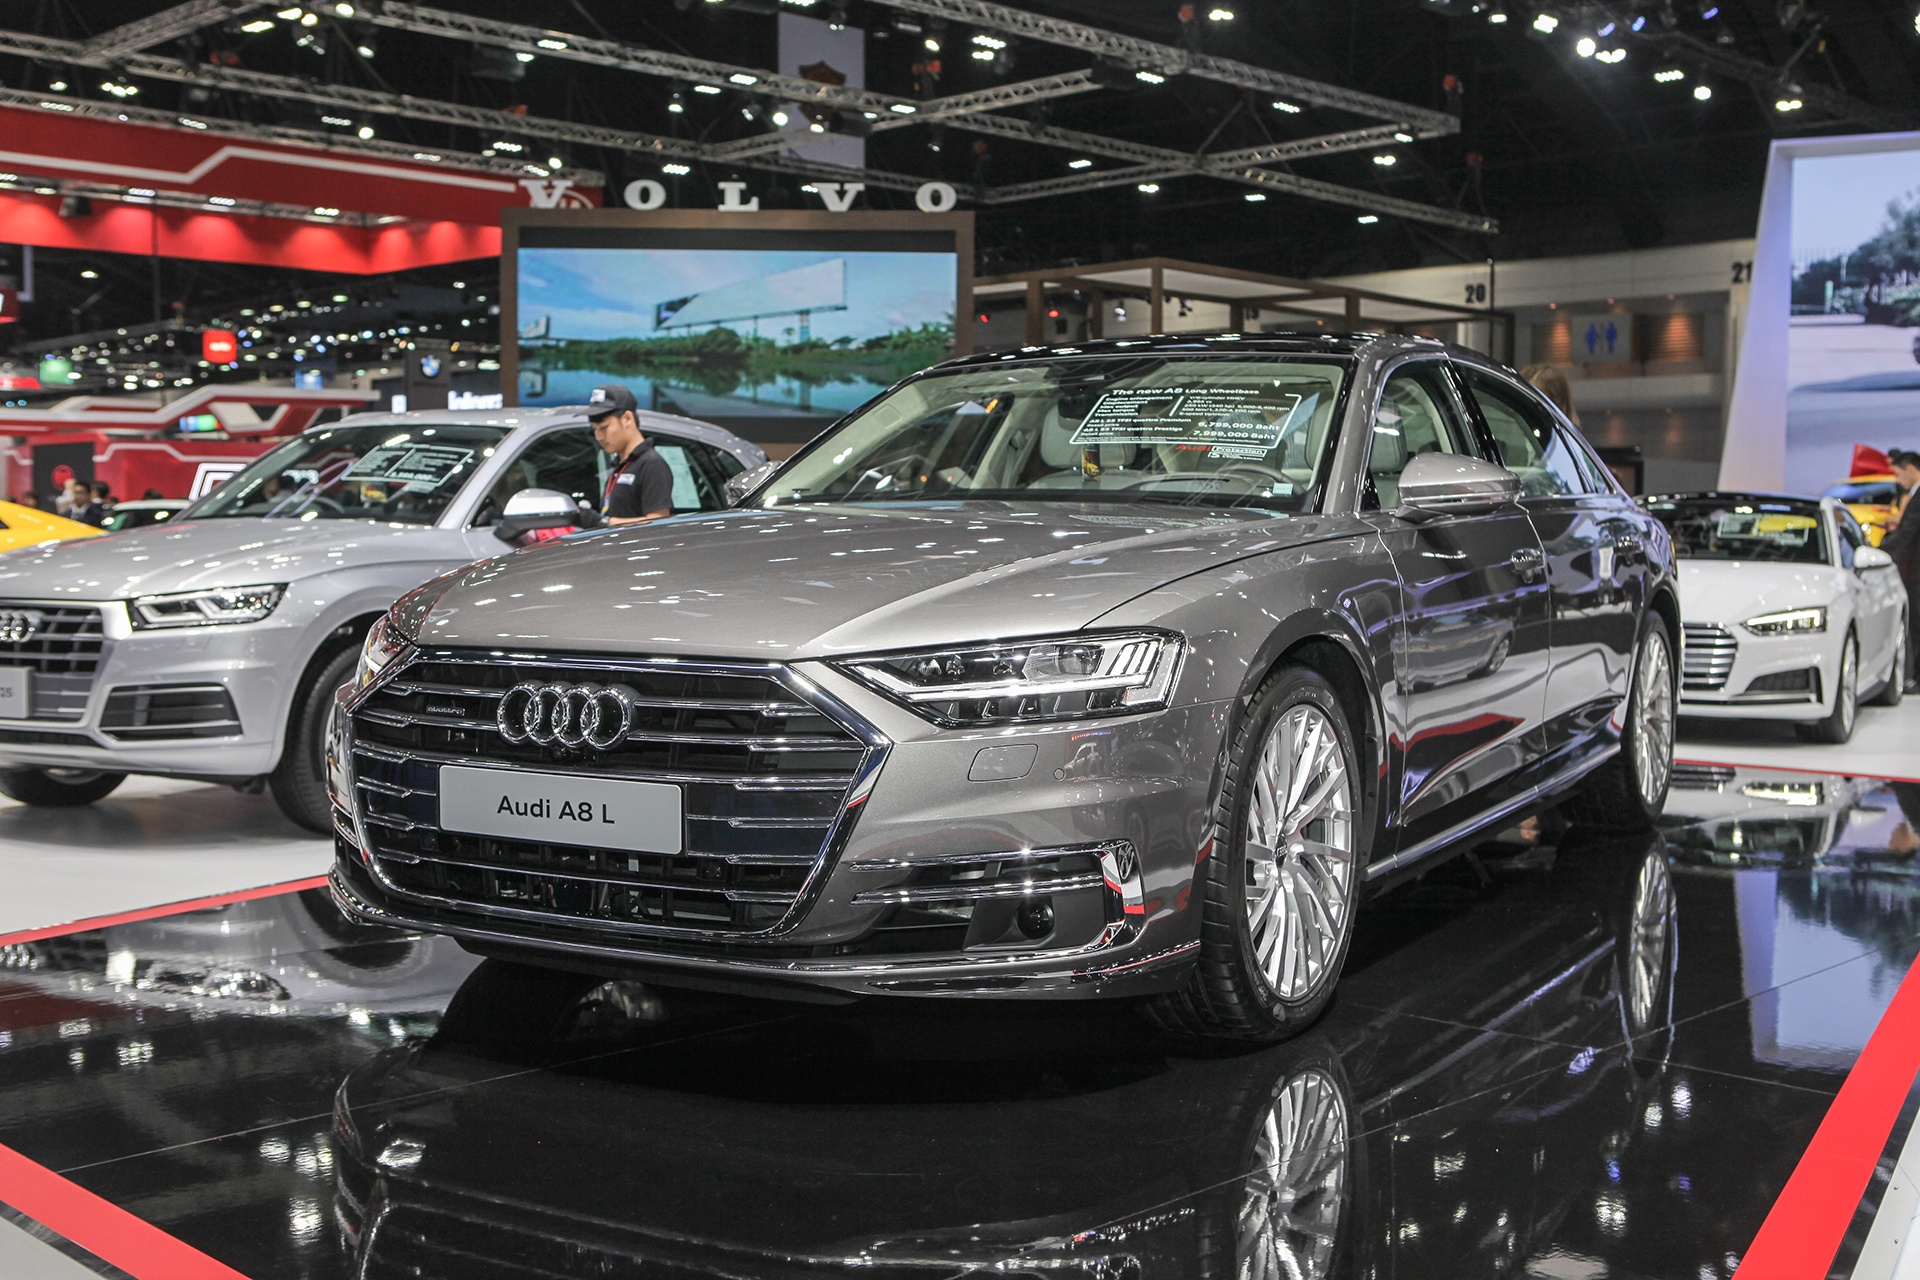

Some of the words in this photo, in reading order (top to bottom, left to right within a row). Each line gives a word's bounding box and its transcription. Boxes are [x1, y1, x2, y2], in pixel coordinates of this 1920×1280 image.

[518, 179, 957, 213] VOLVO
[1731, 260, 1753, 284] 21
[1465, 283, 1486, 304] 20
[1193, 430, 1249, 438] 7,999,000
[1251, 431, 1276, 440] Baht
[1198, 421, 1253, 429] 6,799,000
[1255, 423, 1280, 431] Baht
[1213, 446, 1263, 455] Protection
[497, 795, 551, 818] Audi
[558, 800, 593, 822] A8
[603, 803, 615, 824] L
